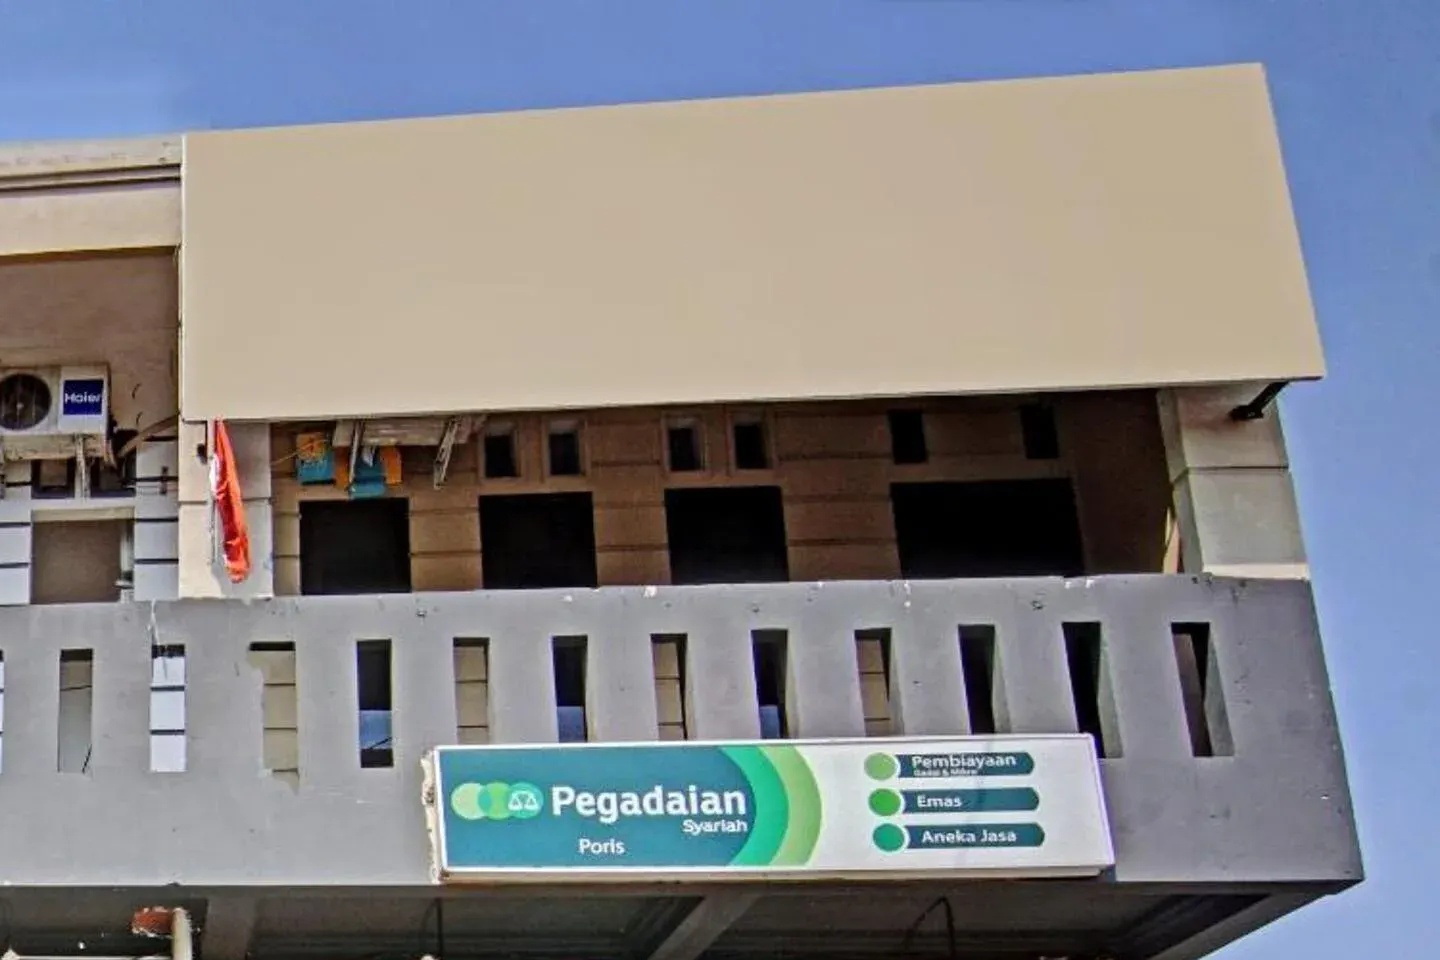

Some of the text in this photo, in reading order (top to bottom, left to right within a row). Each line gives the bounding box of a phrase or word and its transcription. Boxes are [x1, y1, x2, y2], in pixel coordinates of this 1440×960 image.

[65, 392, 102, 404] Haier
[912, 754, 1016, 769] Pembiayaan
[551, 785, 747, 823] Pegadaian
[917, 795, 962, 808] Emas
[683, 819, 748, 836] Syariah
[922, 829, 1017, 843] Aneka Jasa
[578, 838, 626, 855] Poris
